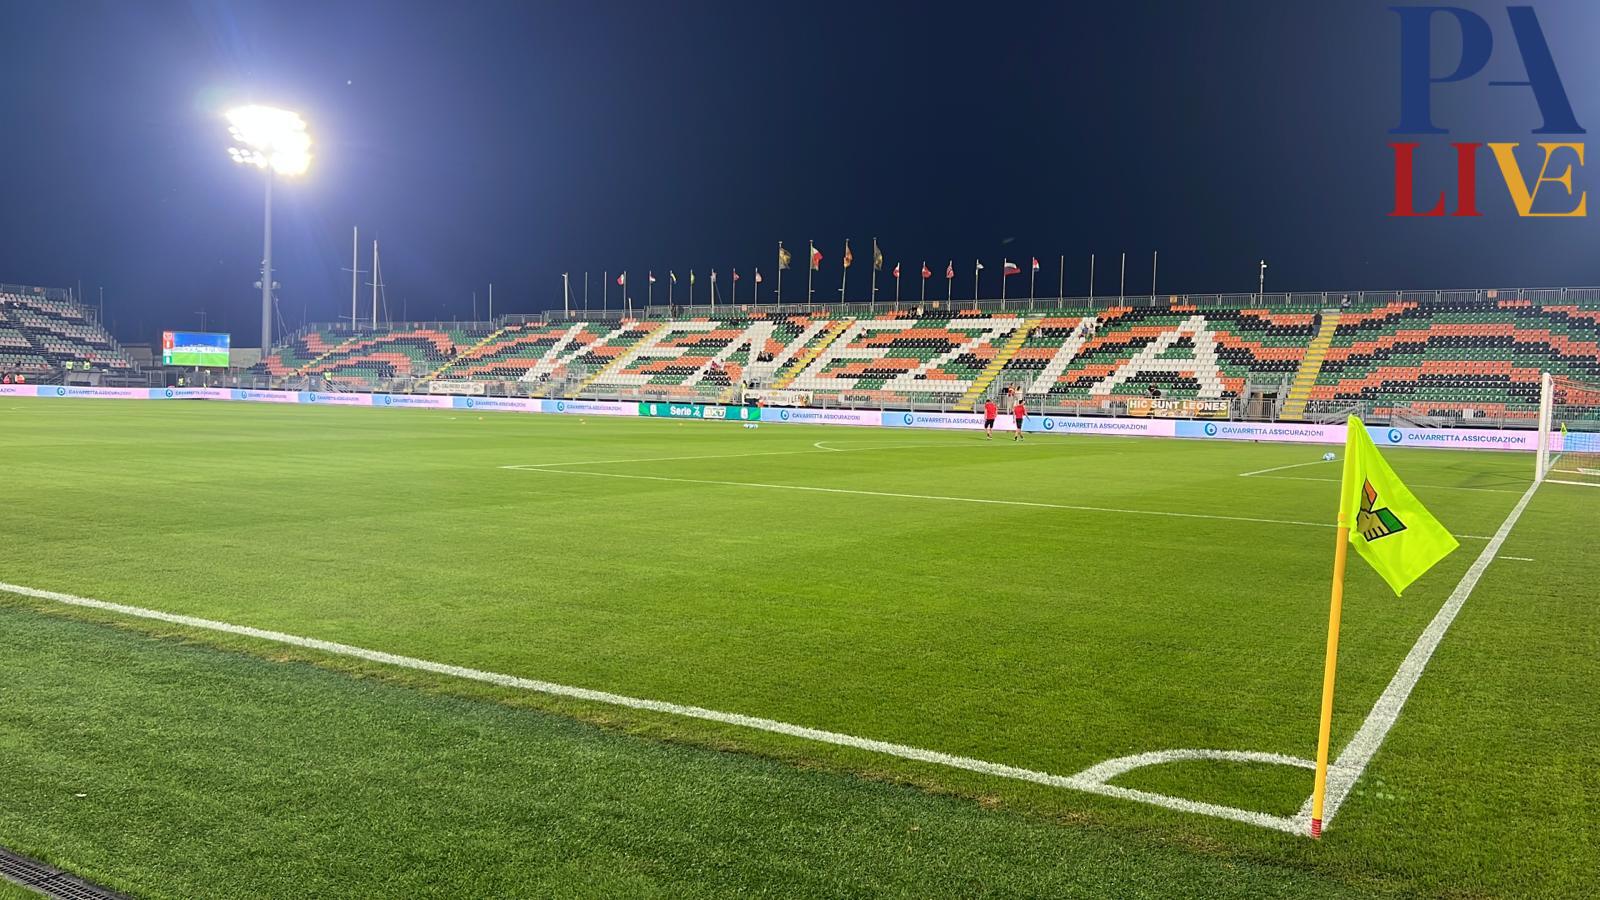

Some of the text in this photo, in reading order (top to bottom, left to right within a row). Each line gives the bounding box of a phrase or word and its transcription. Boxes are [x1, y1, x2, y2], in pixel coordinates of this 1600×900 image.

[518, 315, 1224, 398] VENEZIA
[670, 405, 691, 416] Serie
[1129, 400, 1227, 411] HIC SUNT LEONES
[917, 416, 952, 424] CAVARRETTA
[1058, 421, 1148, 430] CAVARRETTA ASSICURAZIONI
[1222, 427, 1324, 437] CAVARRETTA ASSICURAZIONI
[1408, 433, 1526, 445] CAVARRETTA ASSICURAZIONI
